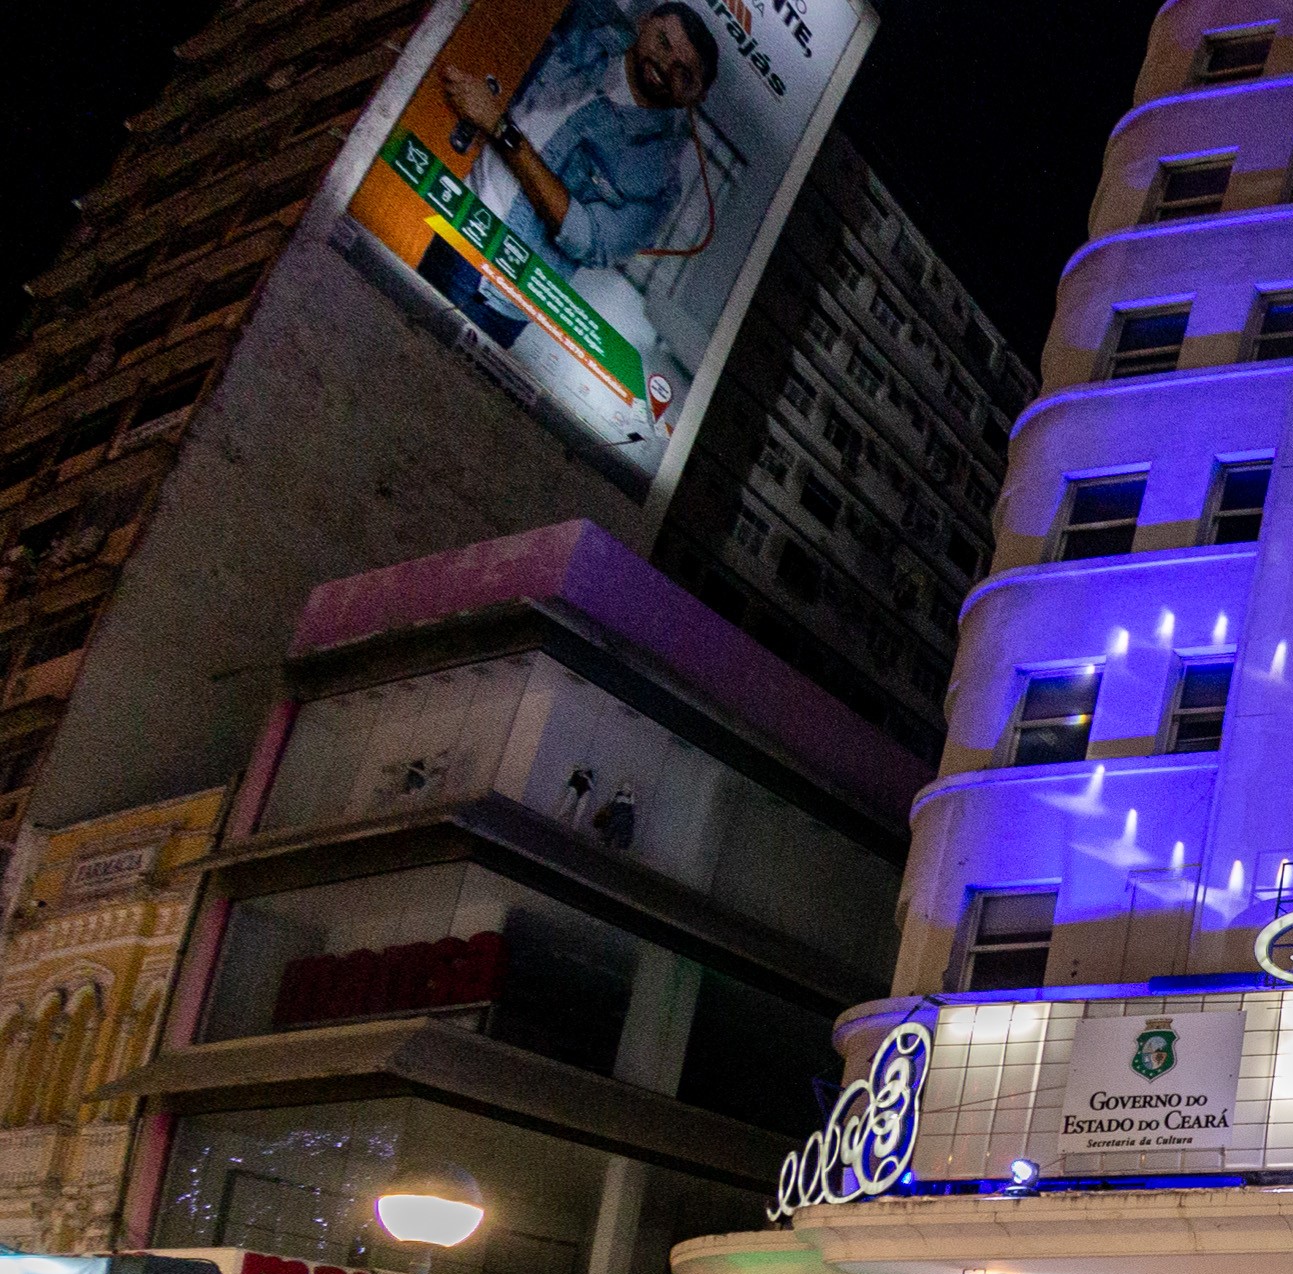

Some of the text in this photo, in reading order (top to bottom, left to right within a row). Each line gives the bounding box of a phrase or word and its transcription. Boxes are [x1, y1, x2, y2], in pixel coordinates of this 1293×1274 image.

[1089, 1091, 1208, 1111] GOVERNO DO
[1062, 1108, 1230, 1135] ESTADO DO CEARÁ
[1086, 1135, 1193, 1148] Secretaria da Cultura
